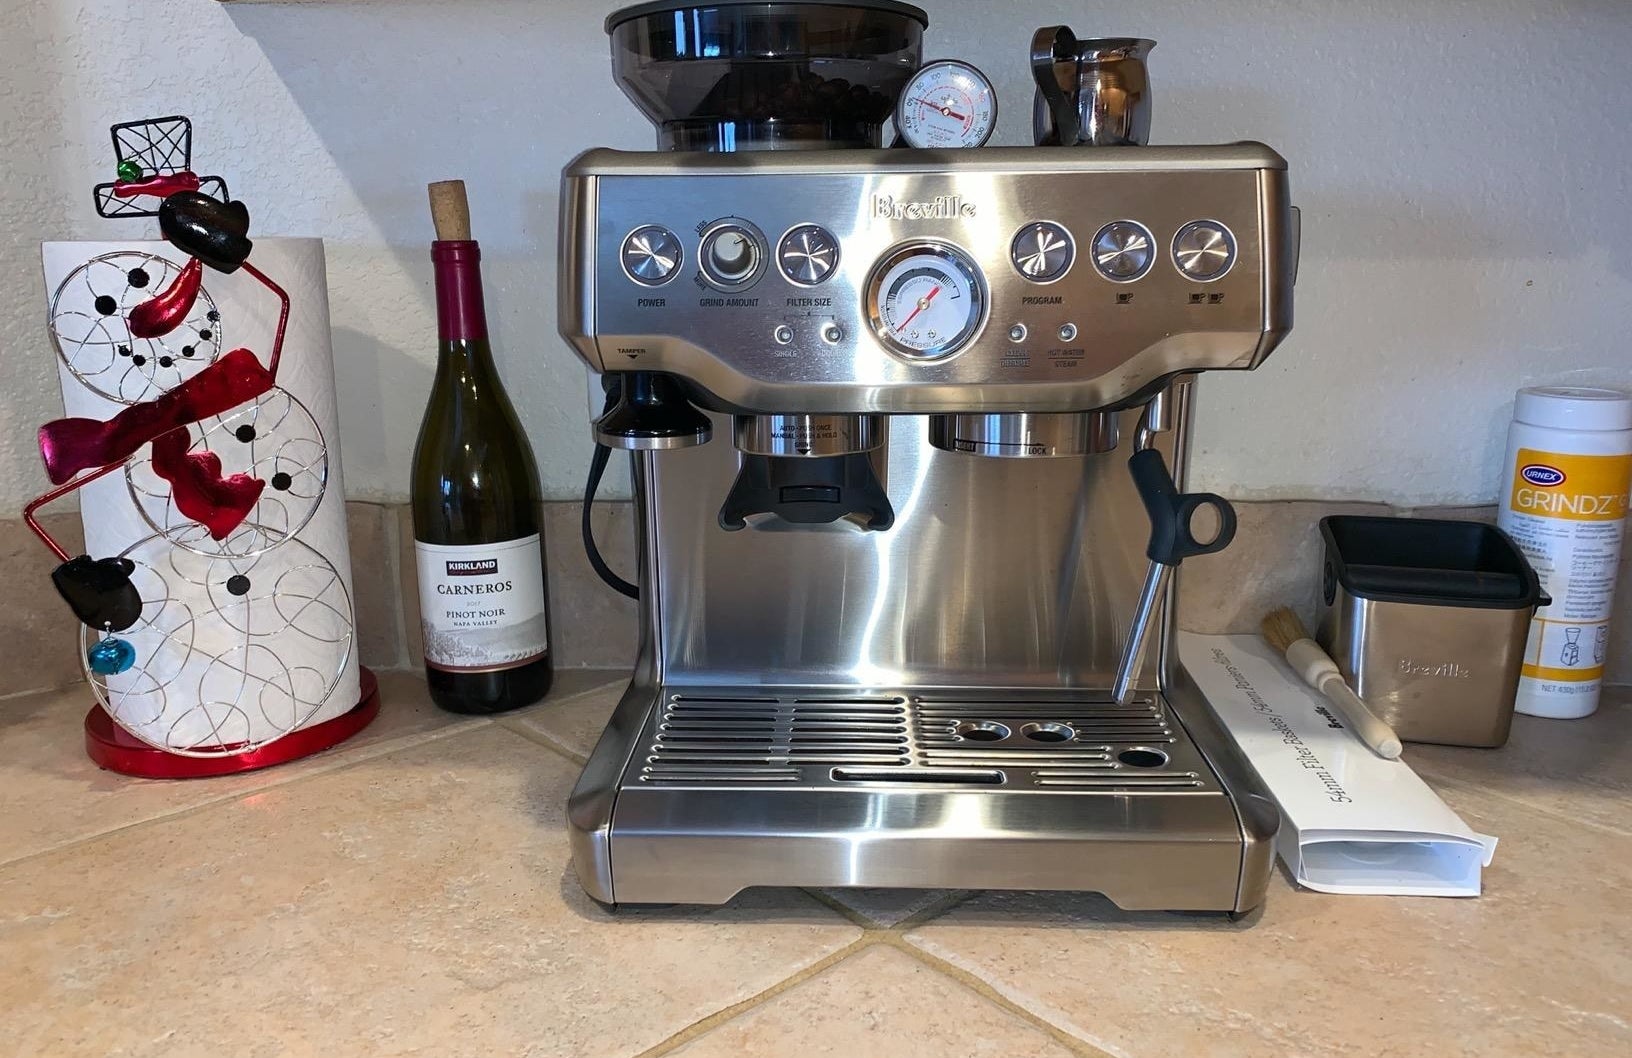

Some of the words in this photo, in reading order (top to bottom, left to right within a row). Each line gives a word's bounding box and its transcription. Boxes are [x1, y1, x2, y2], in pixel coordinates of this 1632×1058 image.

[873, 194, 977, 220] Breville
[638, 298, 666, 307] POWER
[700, 298, 724, 307] GRIND
[726, 298, 760, 307] AMOUNT
[786, 297, 813, 307] FILTER
[814, 297, 832, 307] SIZE
[1022, 296, 1063, 305] PROGRAM
[1028, 447, 1047, 455] LOCK
[1526, 469, 1557, 481] URNEX
[448, 560, 496, 571] KIRKLAND
[437, 580, 512, 596] CARNEROS
[446, 610, 476, 619] PINOT
[479, 608, 506, 618] NOIR
[472, 619, 498, 627] VALLEY
[1296, 743, 1326, 770] Filter
[1316, 771, 1353, 803] 54mm
